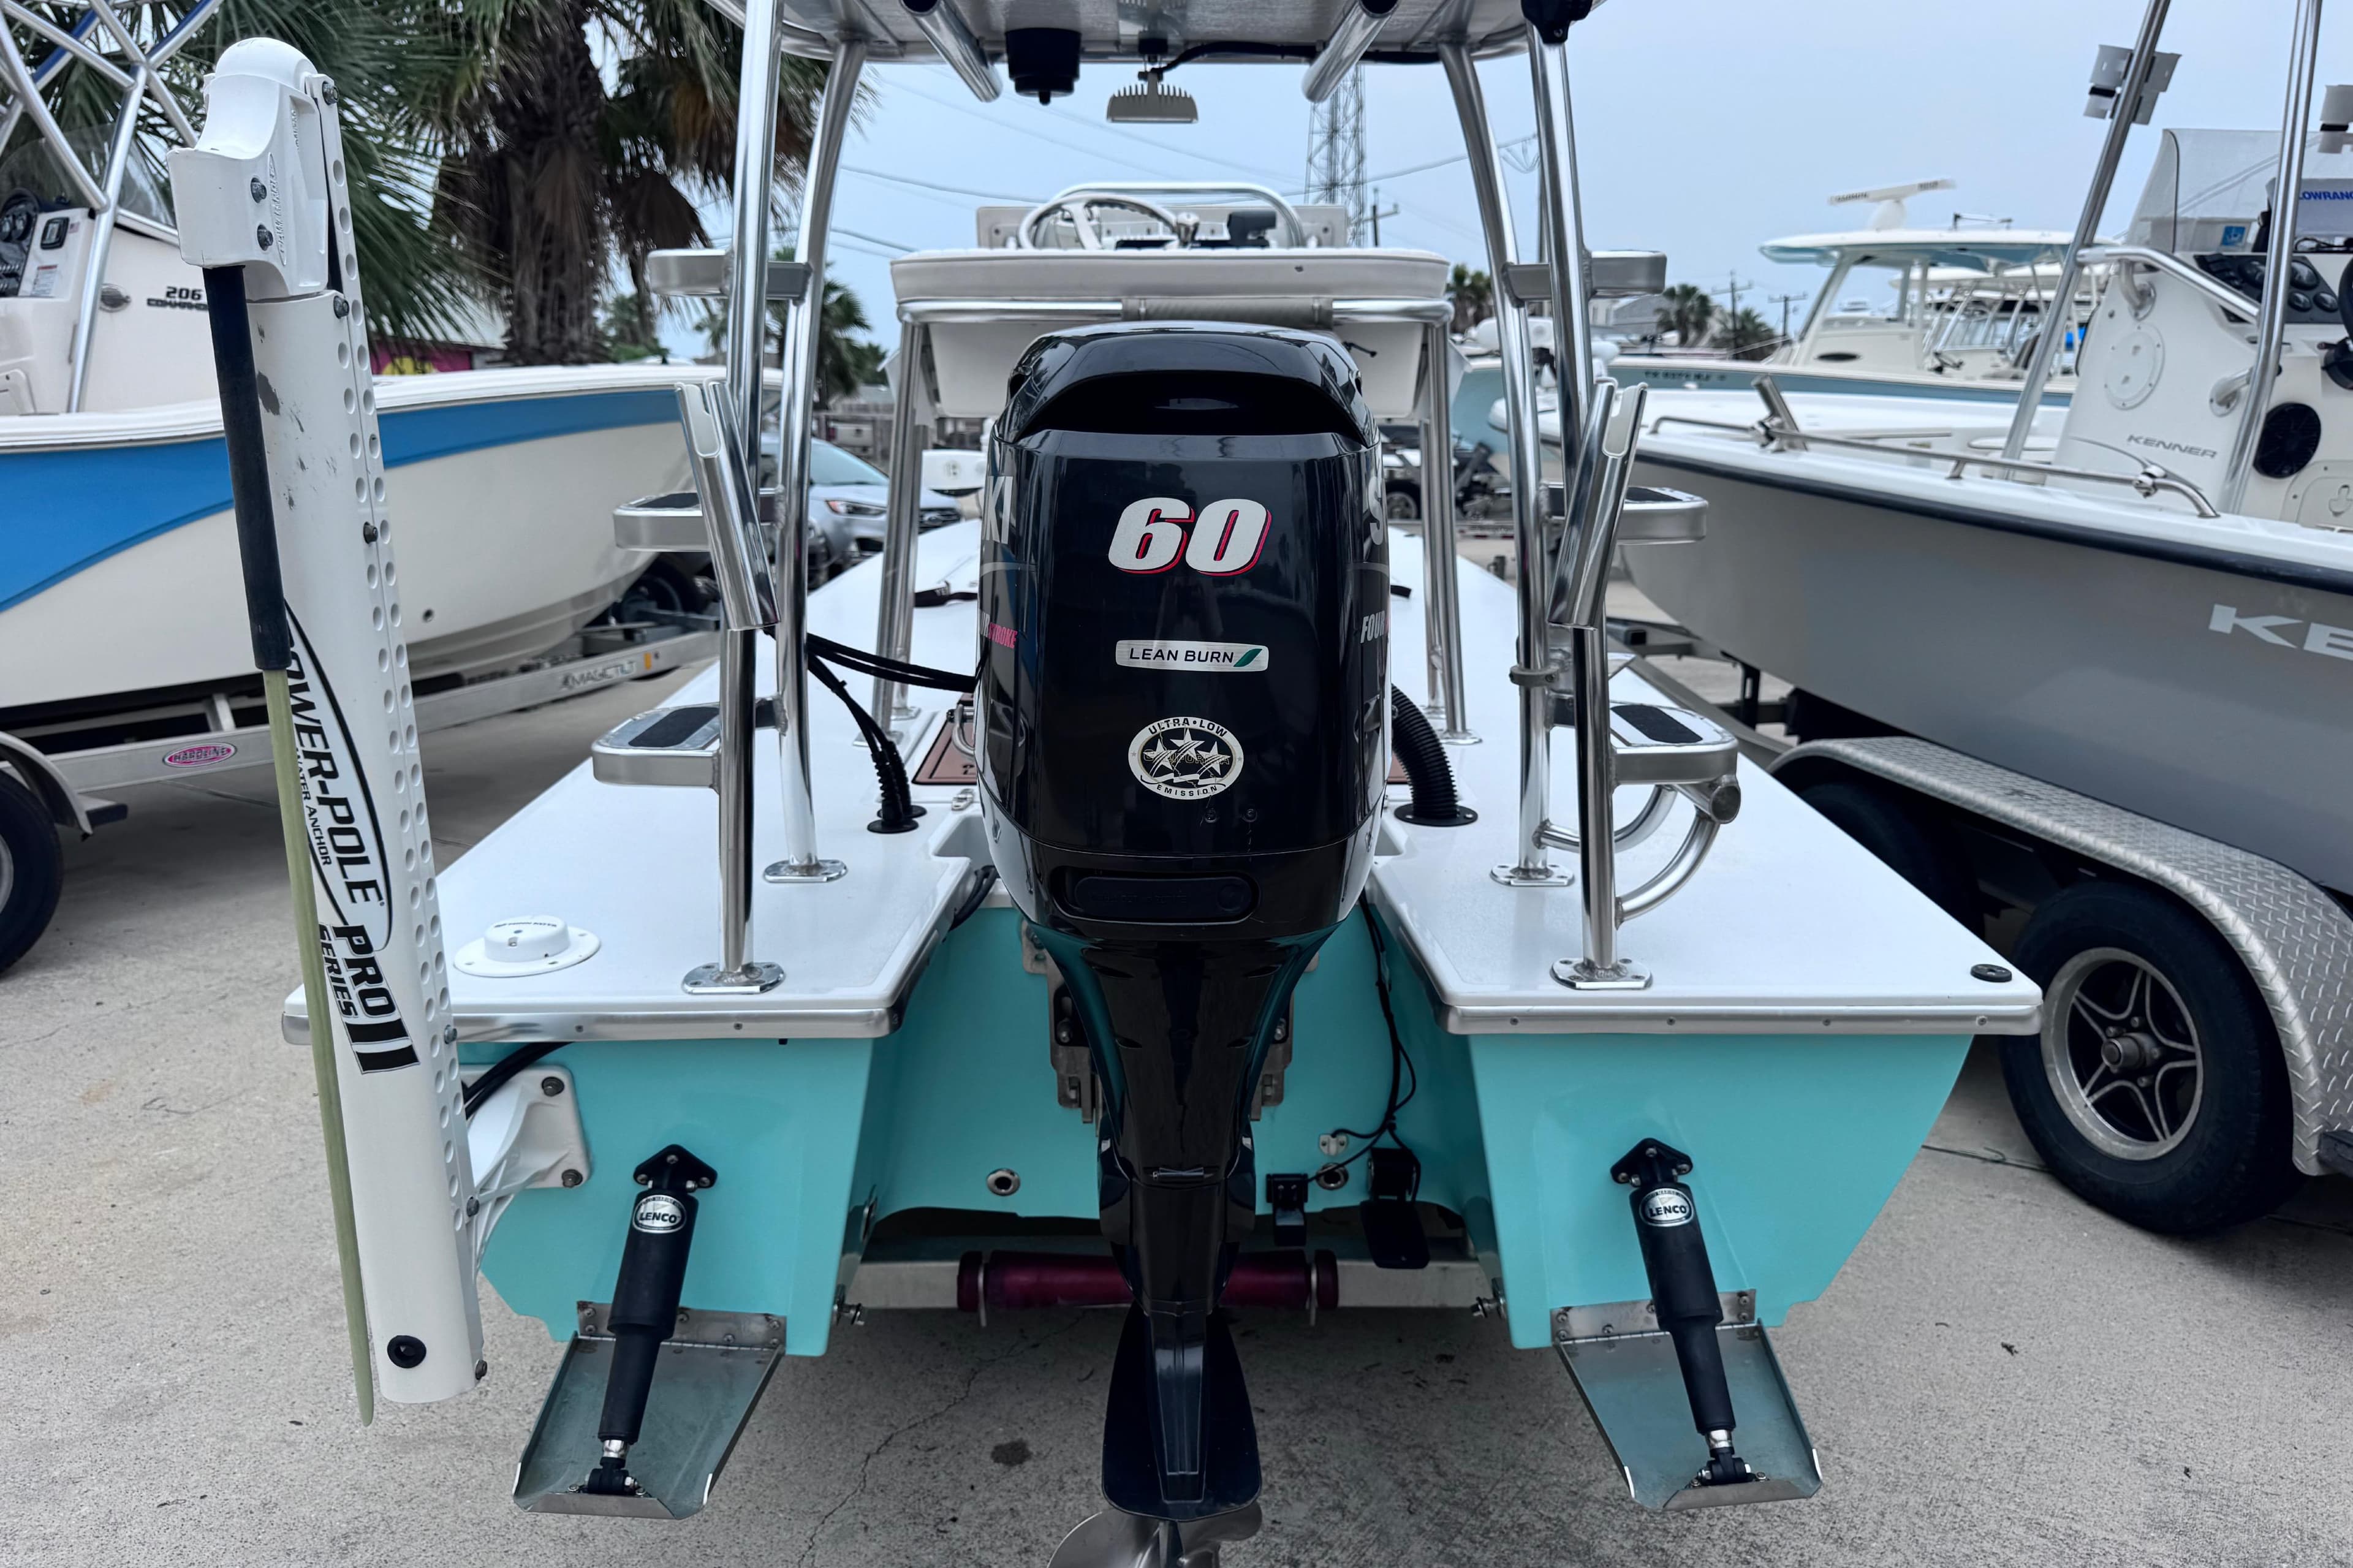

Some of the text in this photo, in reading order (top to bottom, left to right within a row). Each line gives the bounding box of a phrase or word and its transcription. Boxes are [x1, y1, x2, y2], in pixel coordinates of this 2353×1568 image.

[166, 286, 203, 300] 206
[2127, 434, 2218, 459] KENNER
[1108, 497, 1272, 577] 60
[1129, 647, 1234, 664] LEAN BURN
[1148, 718, 1227, 738] ULTRA LOW
[287, 625, 383, 904] OWER-POLE
[1156, 784, 1218, 797] EMISSION
[318, 923, 357, 1017] SERIES
[333, 924, 396, 1017] PRO
[638, 1212, 678, 1224] LENCO
[1648, 1205, 1688, 1218] LENCO
